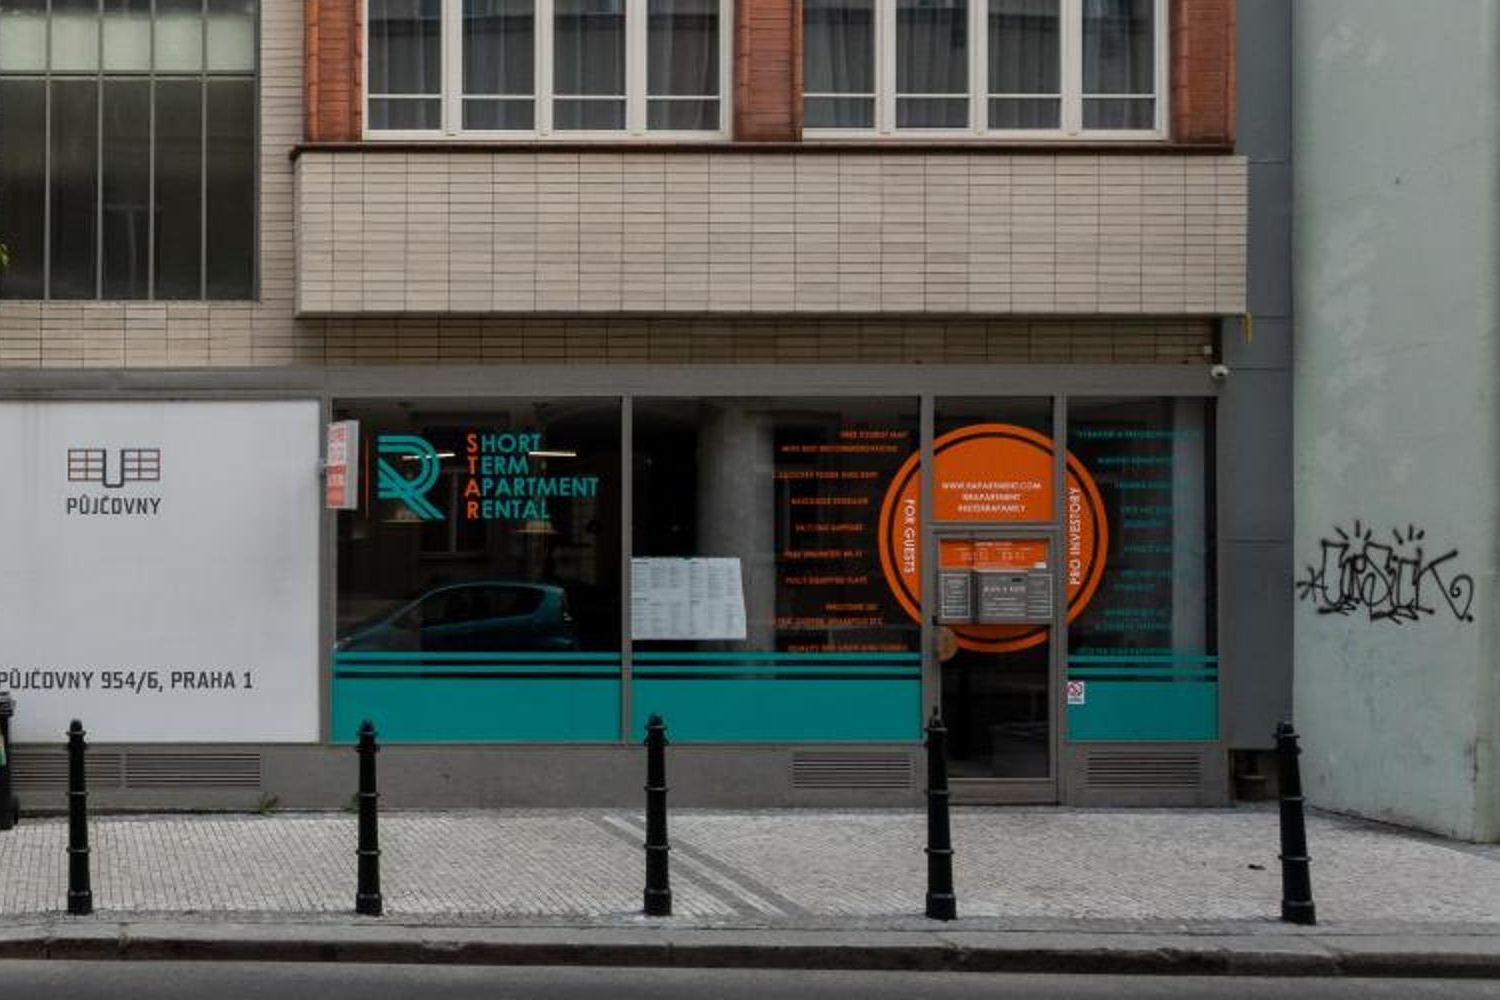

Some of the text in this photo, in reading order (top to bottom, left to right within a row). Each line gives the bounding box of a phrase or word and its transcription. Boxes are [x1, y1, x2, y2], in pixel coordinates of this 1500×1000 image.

[467, 434, 542, 453] SHORT
[467, 456, 529, 475] TERM
[465, 478, 600, 497] APARTMENT
[67, 494, 162, 515] PŮJČOVNY
[467, 500, 551, 519] RENTAL
[903, 499, 917, 574] FOR GUESTS
[100, 671, 163, 694] 954/6,
[171, 671, 236, 690] PRAHA
[243, 671, 254, 690] 1
